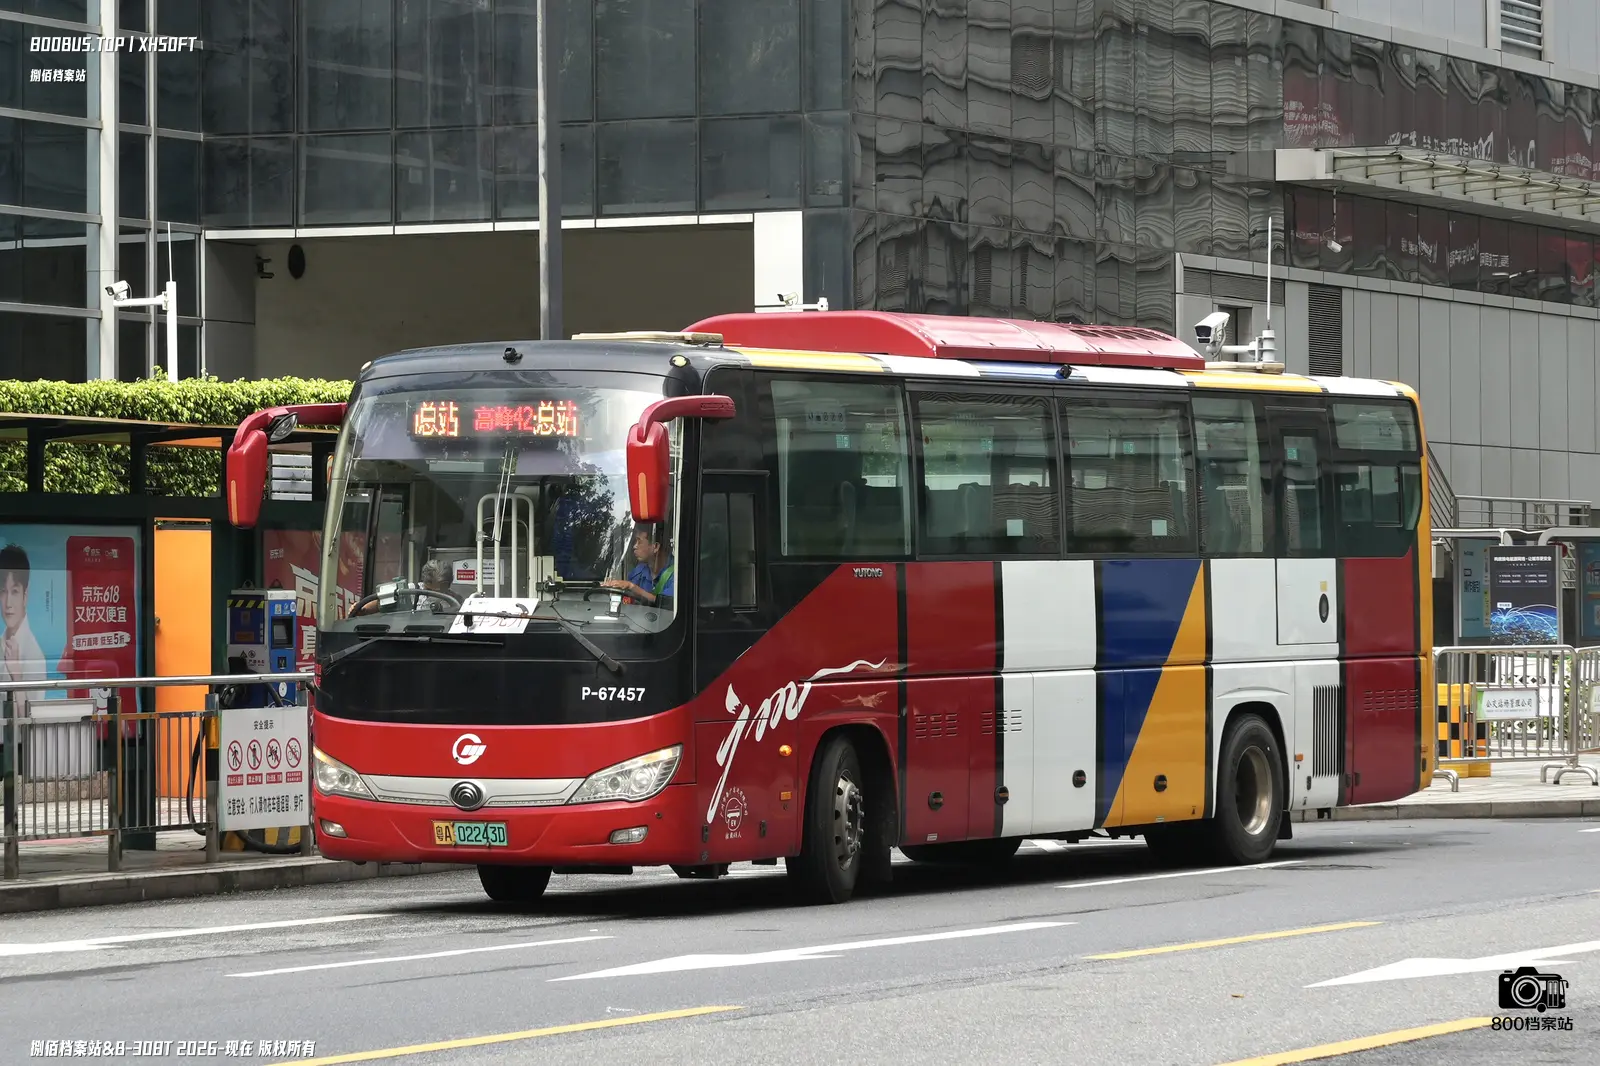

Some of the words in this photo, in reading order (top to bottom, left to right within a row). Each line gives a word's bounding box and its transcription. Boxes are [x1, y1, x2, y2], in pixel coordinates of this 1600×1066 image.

[414, 401, 459, 437] 总站
[853, 567, 883, 578] YUTONG
[82, 585, 120, 603] 京东618
[74, 606, 127, 623] 又好又便宜
[581, 686, 646, 702] P-67457
[253, 719, 274, 731] 安全提示
[457, 825, 506, 843] 02243D
